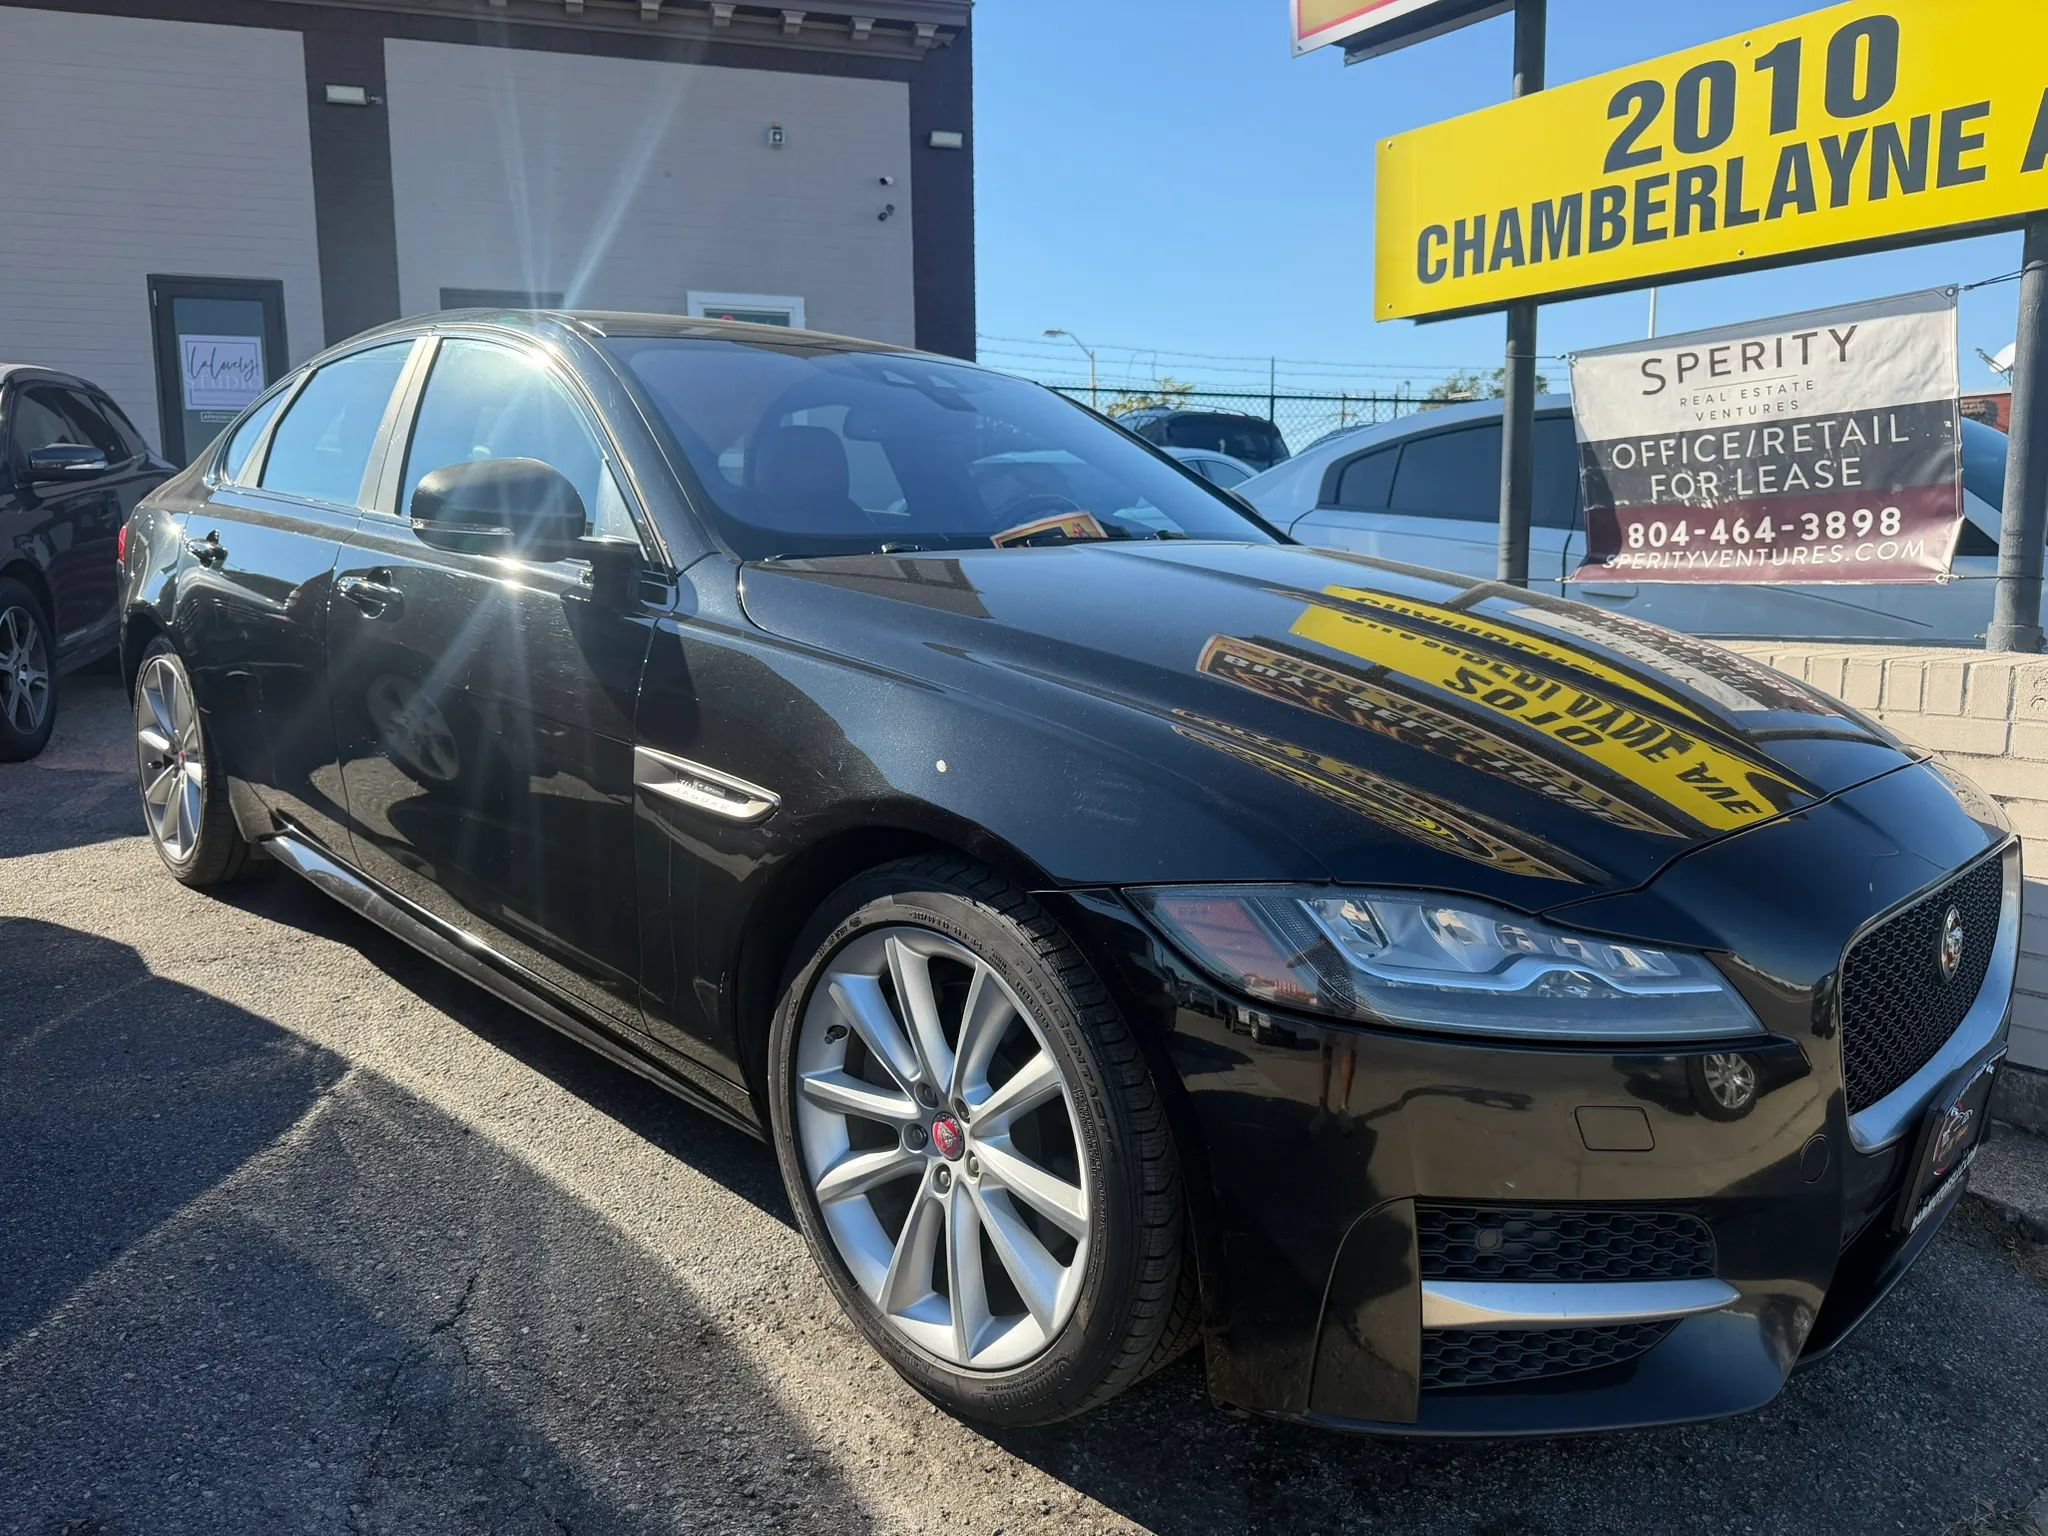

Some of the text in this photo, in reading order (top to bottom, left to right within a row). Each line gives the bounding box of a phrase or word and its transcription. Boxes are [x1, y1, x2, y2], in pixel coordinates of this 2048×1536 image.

[1603, 15, 1901, 175] 2010
[1416, 100, 1991, 285] CHAMBERLAYNE
[1641, 324, 1858, 396] SPERITY
[1680, 380, 1815, 409] REAL ESTATE
[1695, 400, 1800, 422] VENTURES
[1612, 412, 1910, 471] OFFICE/RETAIL
[1650, 456, 1862, 505] FOR LEASE
[1627, 506, 1902, 549] 804-464-3898
[1602, 538, 1926, 571] SPERITYVENTURES.COM
